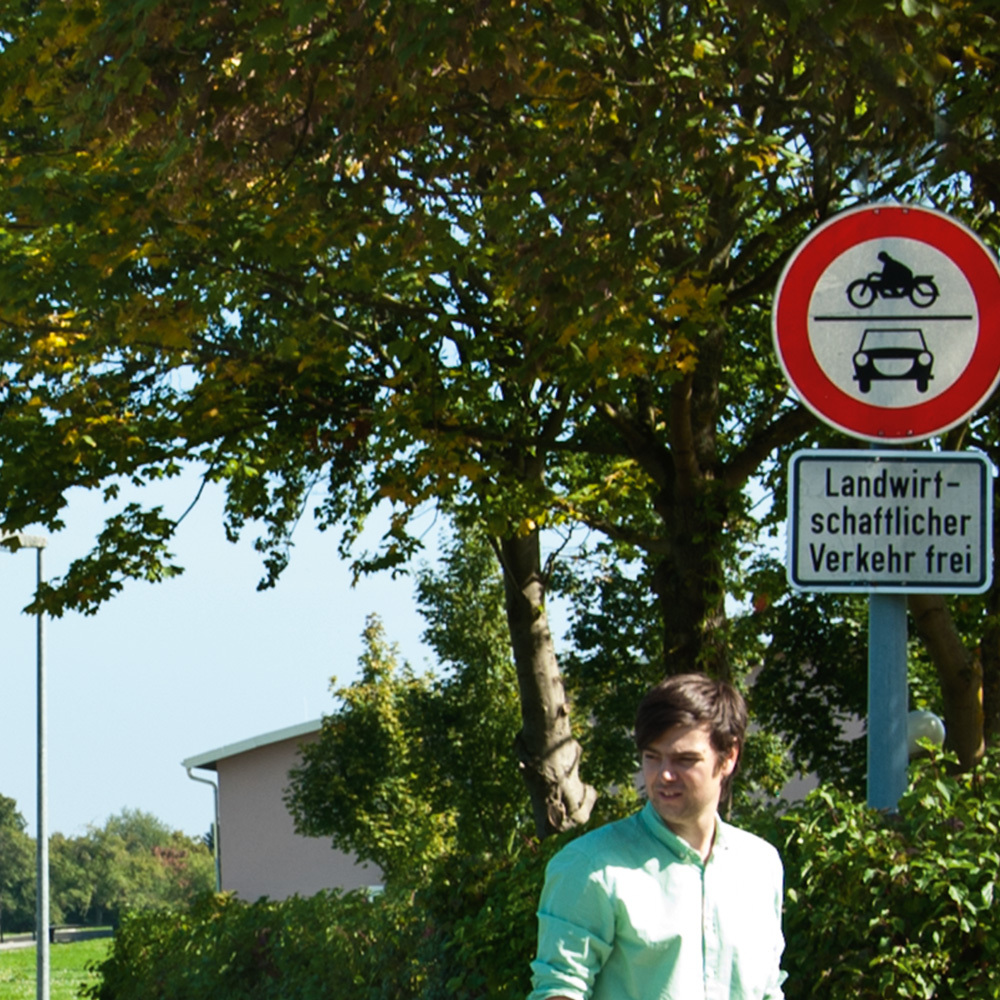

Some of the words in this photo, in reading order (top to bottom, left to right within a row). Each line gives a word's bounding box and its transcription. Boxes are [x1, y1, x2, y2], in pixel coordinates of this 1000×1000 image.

[825, 467, 961, 499] Landwirt-
[810, 505, 972, 536] schaftlicher
[809, 543, 917, 574] Verkehr
[925, 544, 972, 574] frei
